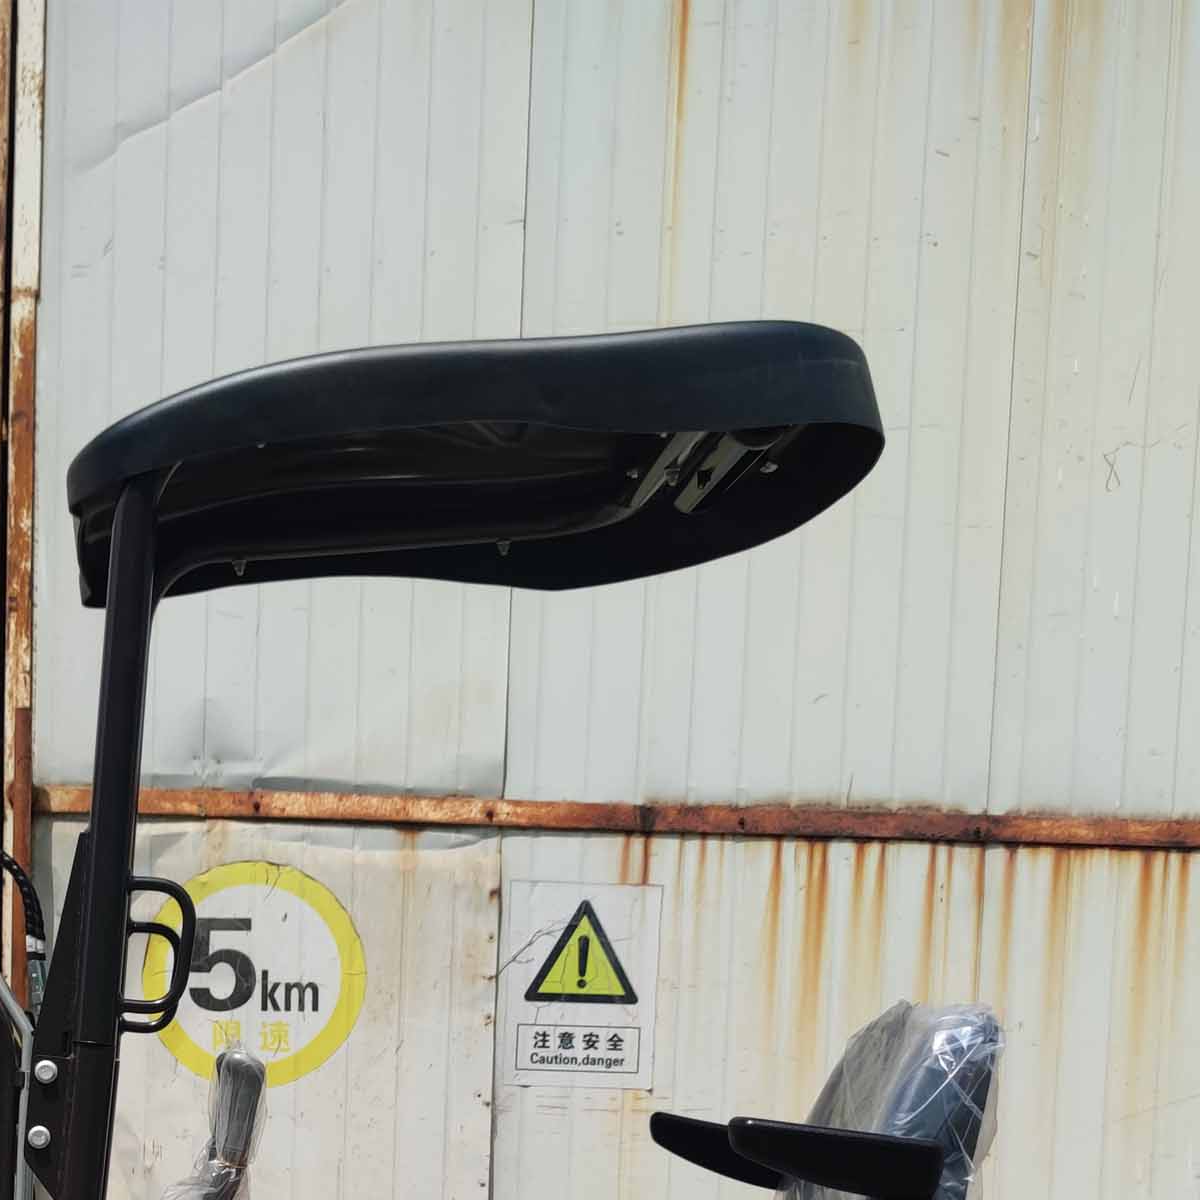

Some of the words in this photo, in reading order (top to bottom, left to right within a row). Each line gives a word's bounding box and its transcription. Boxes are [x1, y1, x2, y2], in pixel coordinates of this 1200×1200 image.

[533, 1031, 624, 1051] 注意安全
[530, 1052, 624, 1068] Caution,danger
